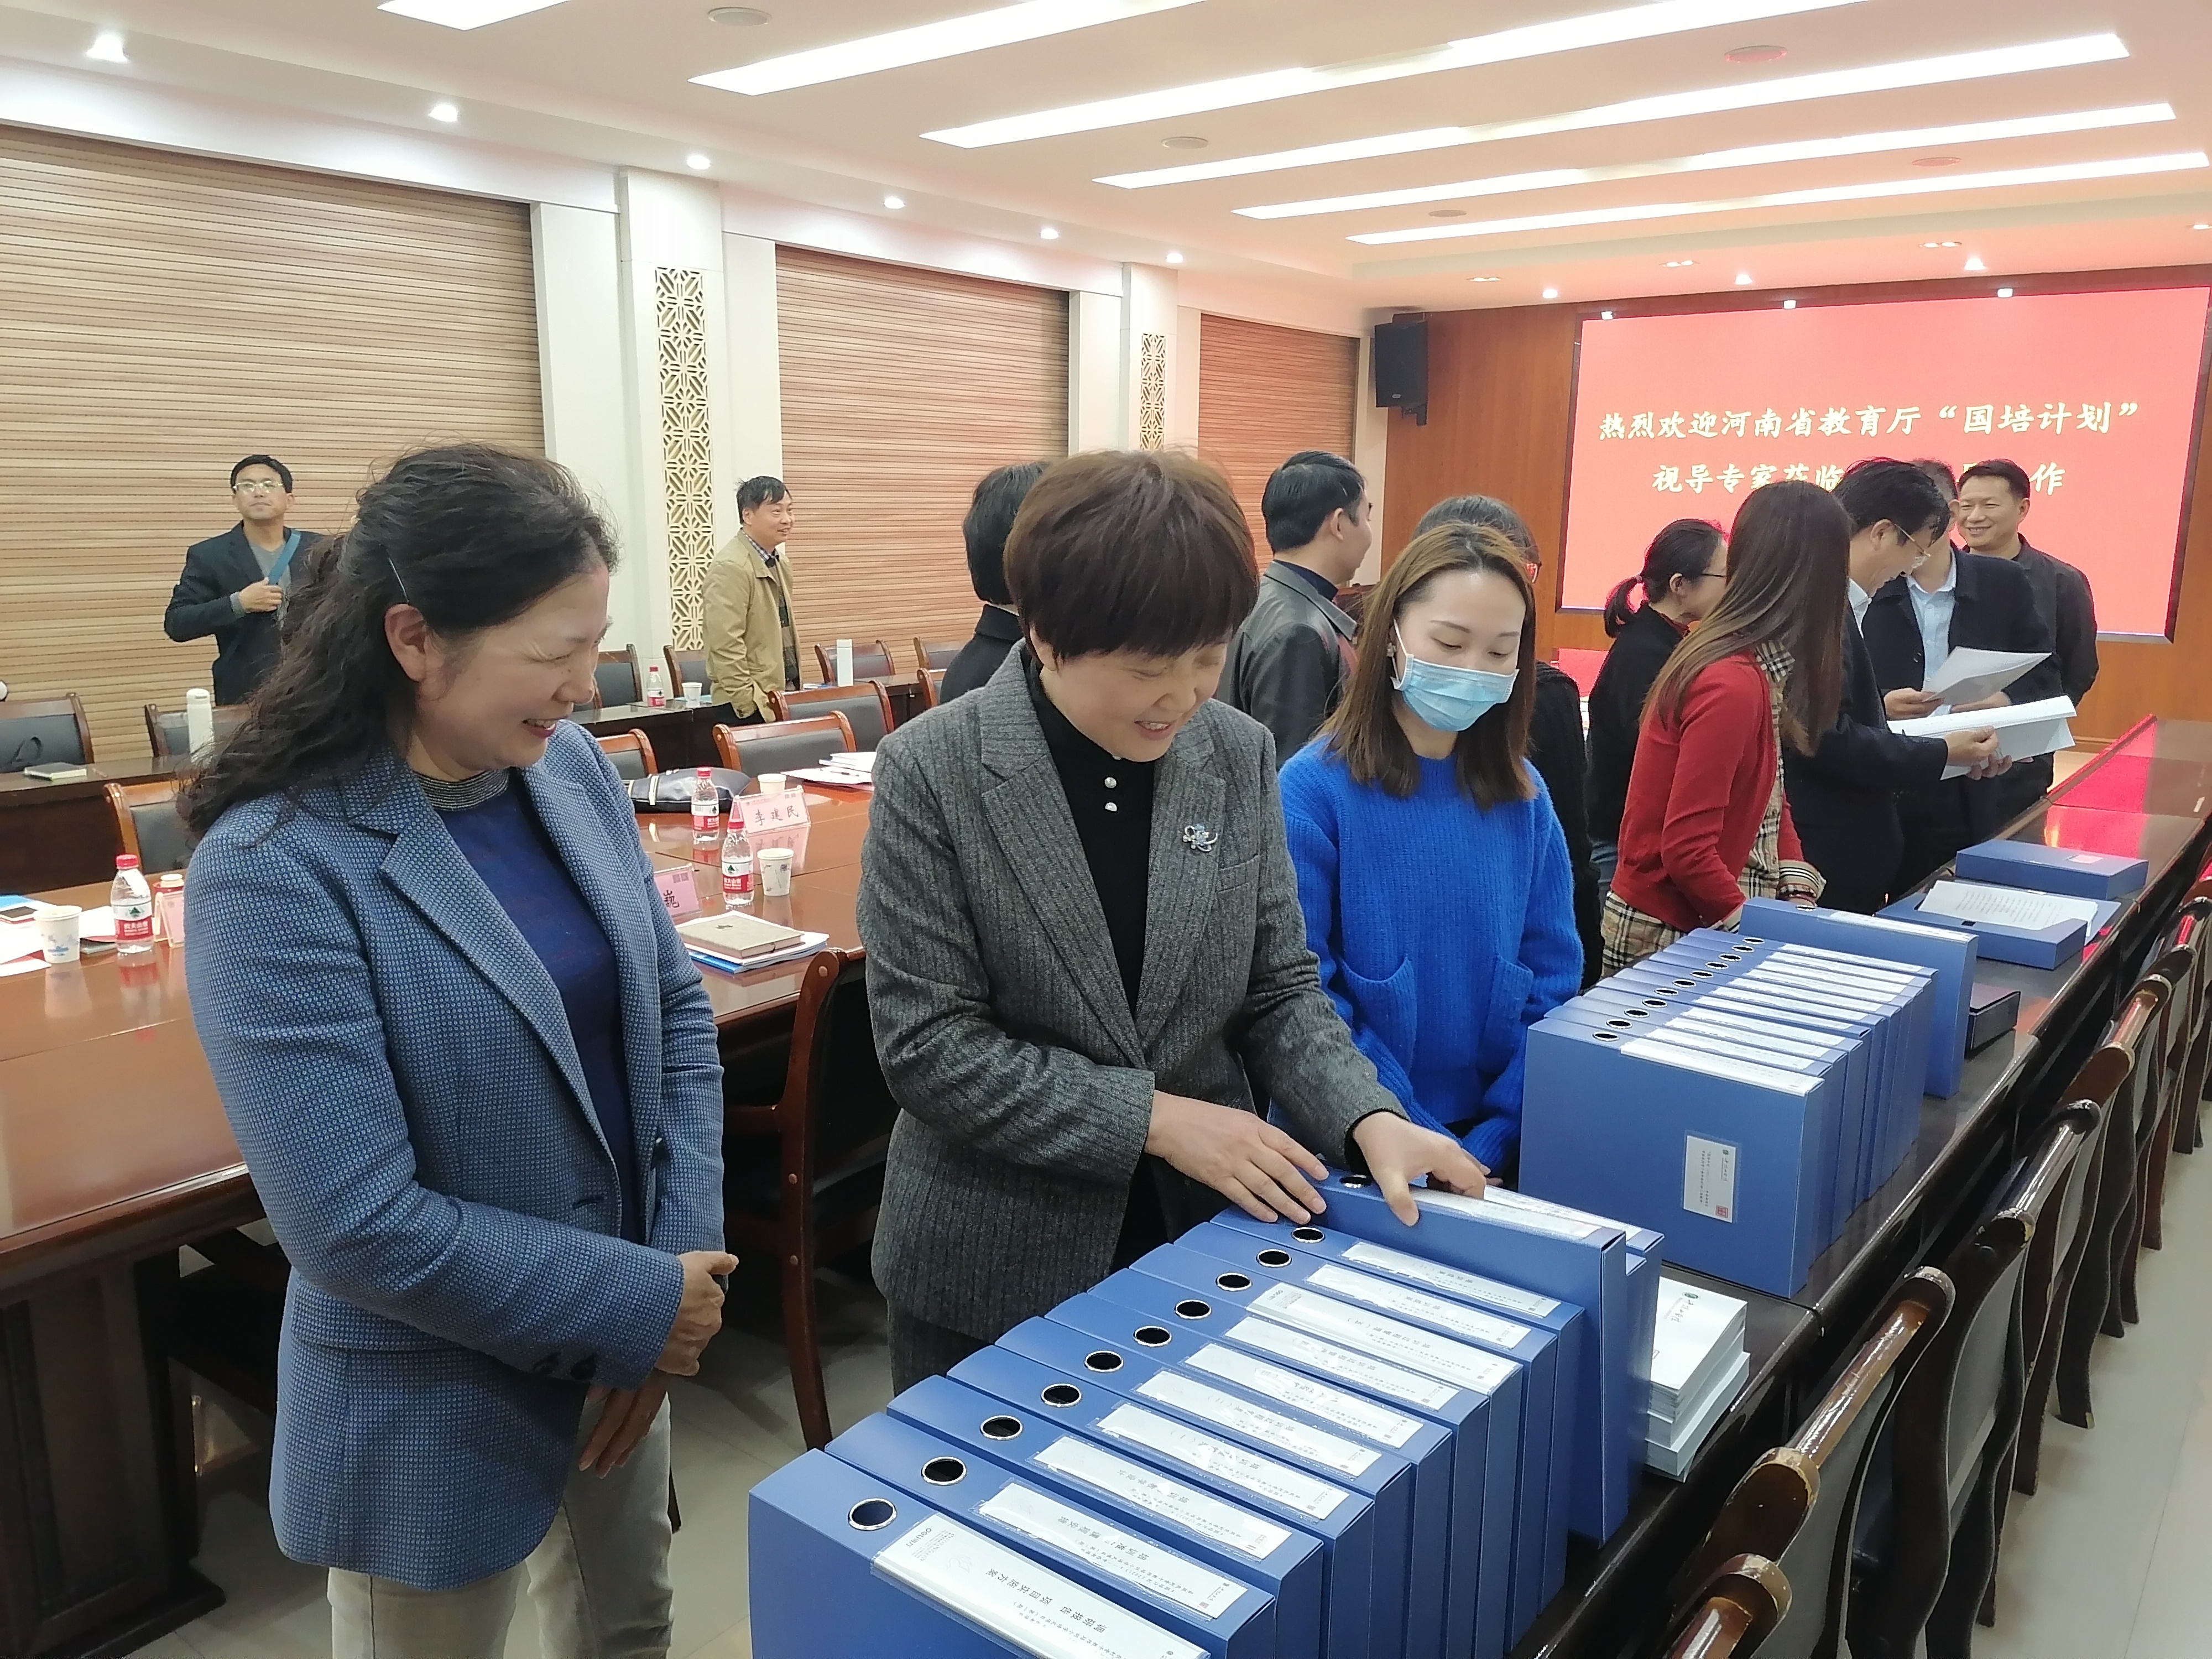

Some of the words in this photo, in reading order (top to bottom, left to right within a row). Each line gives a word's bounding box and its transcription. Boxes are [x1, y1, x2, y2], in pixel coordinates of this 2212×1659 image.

[755, 805, 799, 826] 李建民
[984, 1567, 1053, 1605] 项目实施方案
[1057, 1605, 1109, 1634] 调研报告
